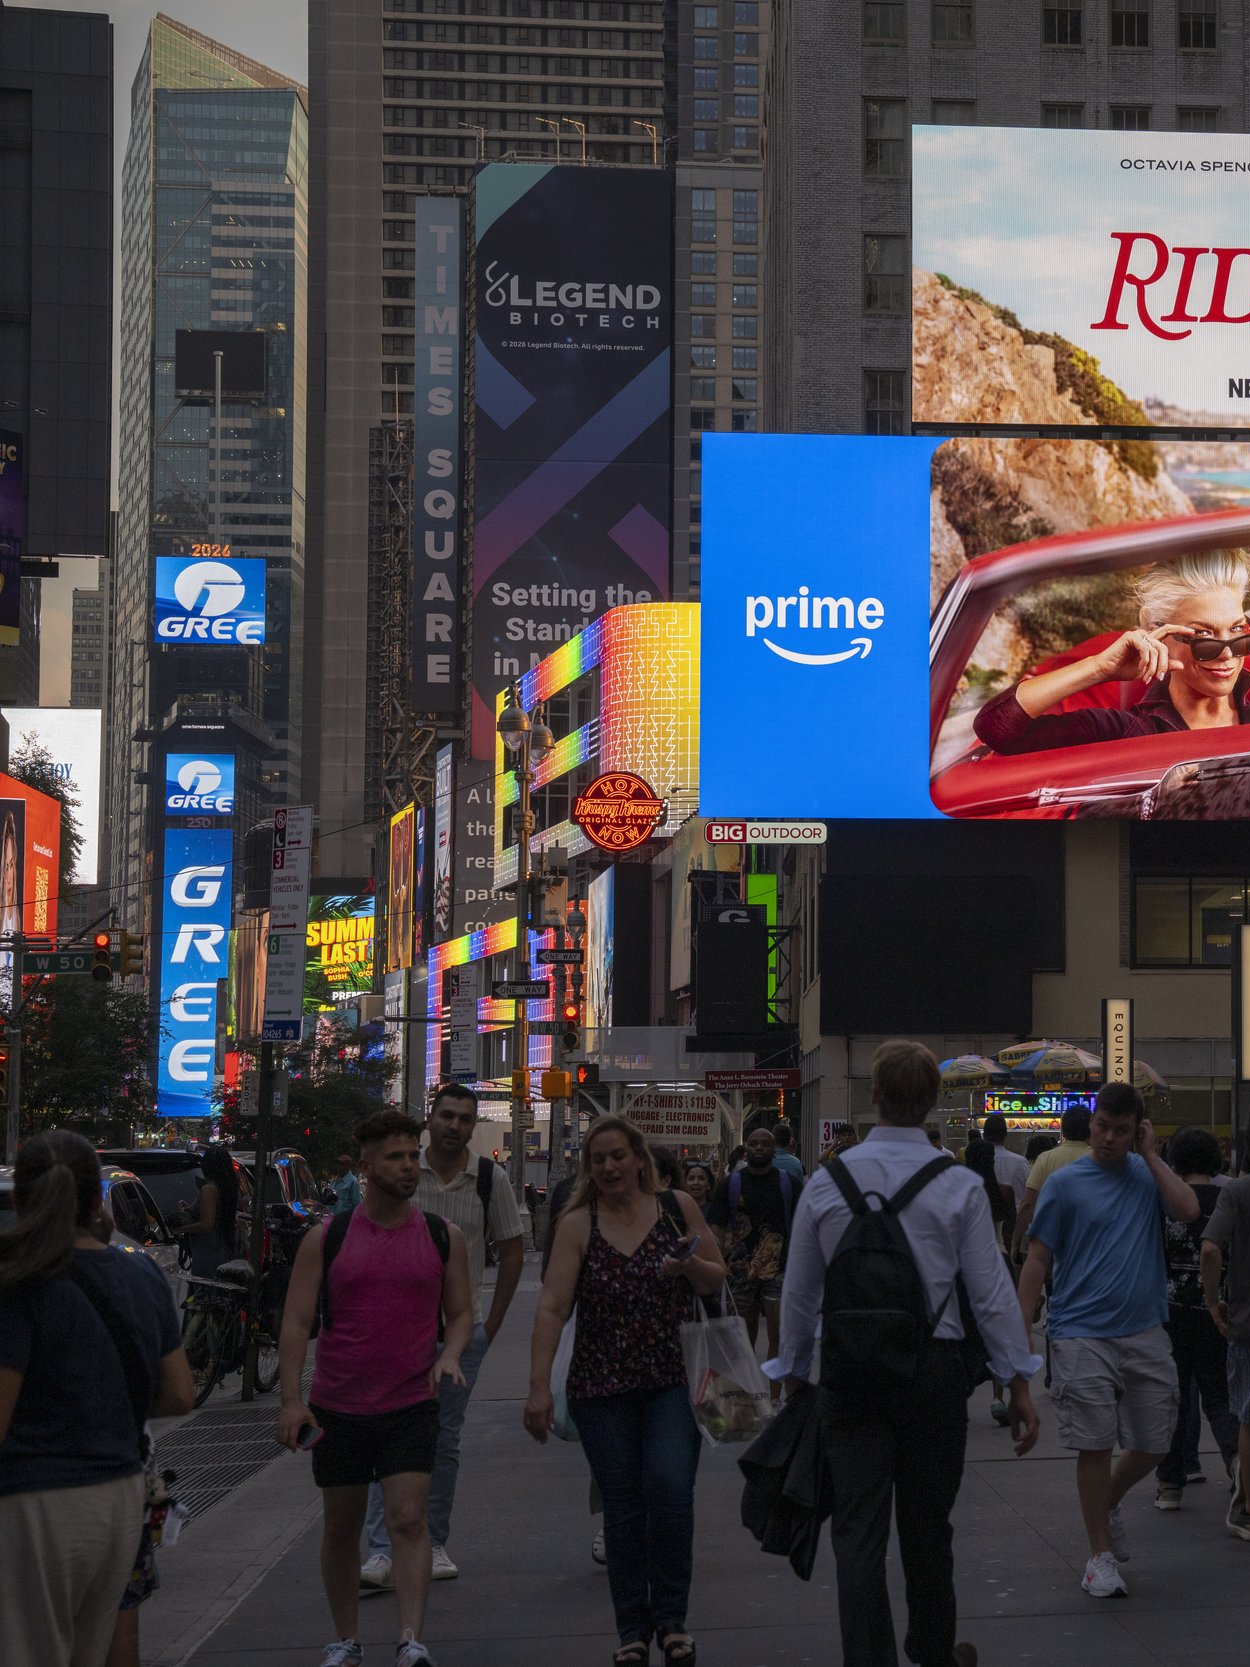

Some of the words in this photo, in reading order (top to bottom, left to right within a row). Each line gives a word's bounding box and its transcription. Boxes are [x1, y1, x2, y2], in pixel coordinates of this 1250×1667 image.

[1119, 158, 1196, 172] OCTAVIA
[509, 275, 662, 310] LEGEND
[424, 224, 458, 416] TIMES
[509, 312, 660, 329] BIOTECH
[527, 341, 552, 350] Legend
[553, 342, 581, 350] Biotech.
[592, 343, 613, 351] rights
[613, 344, 645, 352] reserved.
[192, 543, 232, 558] 2026
[423, 449, 457, 684] SQUARE
[492, 582, 596, 613] Setting
[605, 583, 652, 606] the
[745, 585, 885, 637] prime
[158, 616, 263, 645] GREE
[494, 651, 520, 676] in
[600, 779, 639, 795] HOT
[167, 794, 234, 813] GREE
[467, 788, 481, 804] A
[574, 797, 620, 818] Krispy
[619, 798, 663, 817] Kreme
[578, 816, 622, 824] ORIGINAL
[597, 826, 640, 844] NOW
[712, 825, 744, 841] BIG
[749, 827, 823, 840] OUTDOOR
[273, 885, 293, 893] VEHICLES
[293, 884, 304, 892] ONLY
[270, 937, 277, 952] 6
[321, 940, 369, 966] LAST
[36, 957, 50, 970] W
[60, 956, 85, 970] 50
[323, 966, 351, 975] SOPHIA
[168, 865, 226, 1082] GREE
[327, 974, 348, 982] BUSH
[500, 986, 517, 994] ONE
[525, 985, 542, 993] WAY
[538, 1023, 546, 1034] W
[549, 1023, 560, 1034] 50
[766, 1073, 789, 1081] Theater
[726, 1082, 740, 1090] Jerry
[690, 1095, 717, 1110] $11.99
[665, 1111, 715, 1123] ELECTRONICS
[665, 1124, 681, 1135] SIM
[682, 1124, 709, 1136] CARDS
[823, 1121, 831, 1141] 3
